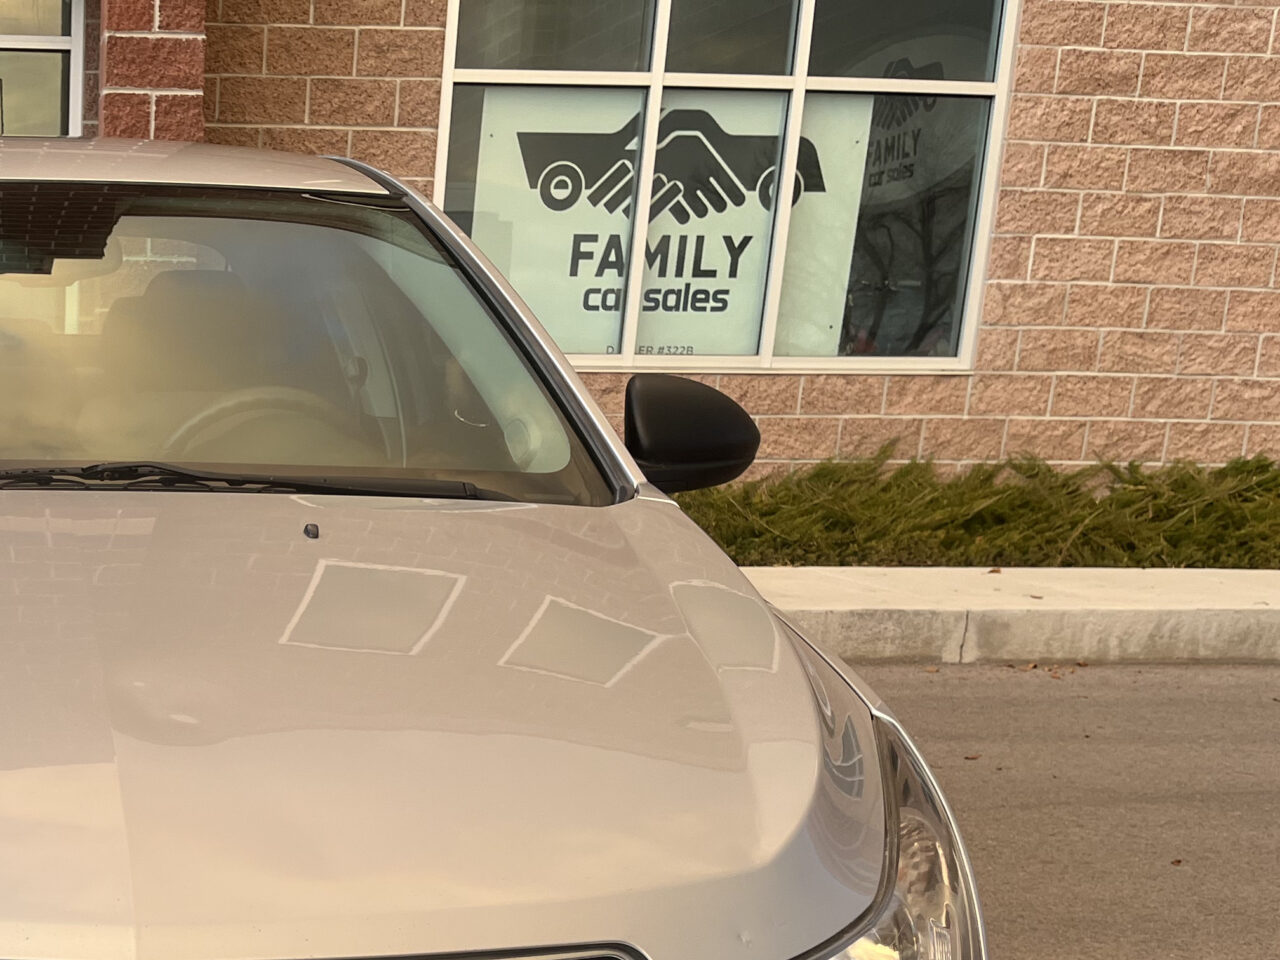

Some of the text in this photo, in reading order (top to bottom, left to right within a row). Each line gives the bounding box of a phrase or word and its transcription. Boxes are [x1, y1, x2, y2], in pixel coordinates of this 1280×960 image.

[569, 233, 754, 279] FAMILY
[583, 282, 730, 312] ca sales
[606, 345, 654, 355] DER
